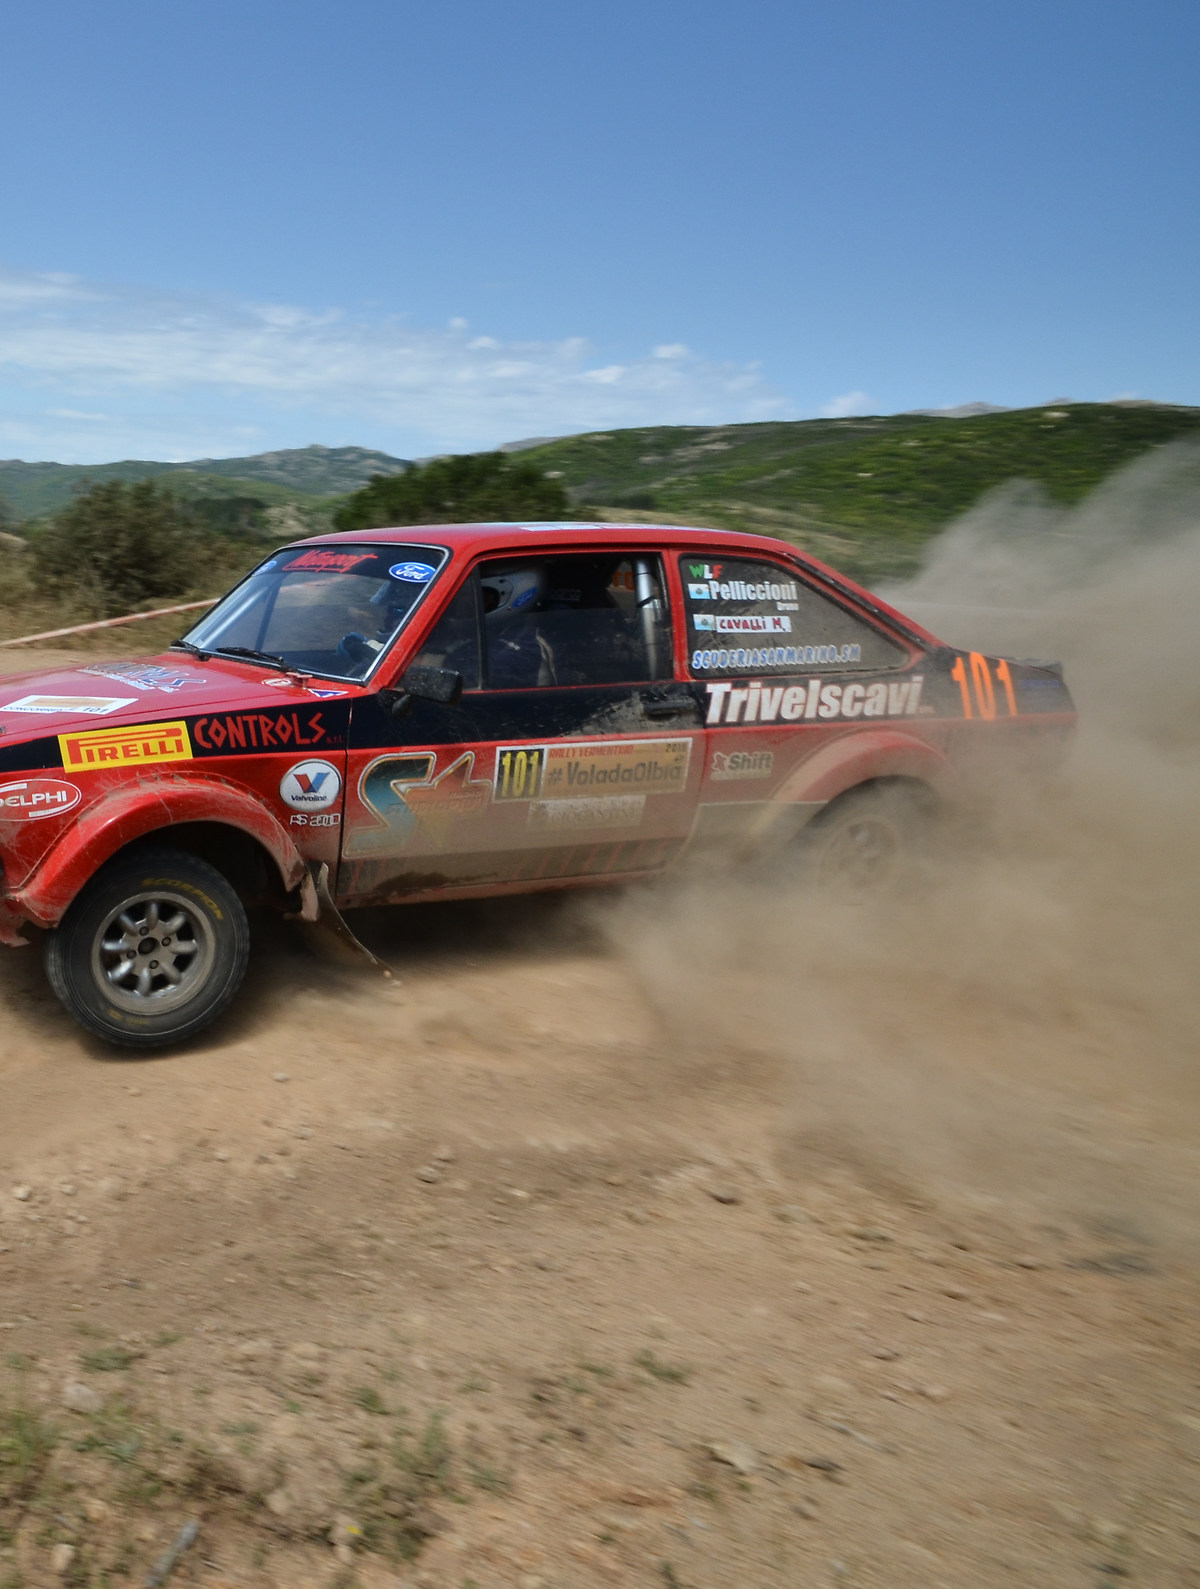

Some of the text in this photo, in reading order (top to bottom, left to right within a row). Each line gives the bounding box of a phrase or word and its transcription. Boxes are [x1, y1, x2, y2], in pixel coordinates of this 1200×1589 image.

[394, 564, 429, 580] Ford
[708, 581, 798, 600] Pelliccioni
[706, 675, 924, 724] Trivelscavi
[952, 651, 1017, 722] 101
[66, 727, 185, 765] PIRELLI
[194, 712, 326, 748] CONTROLS
[549, 747, 575, 759] RALLY
[728, 752, 774, 771] Shift
[501, 751, 540, 797] 101
